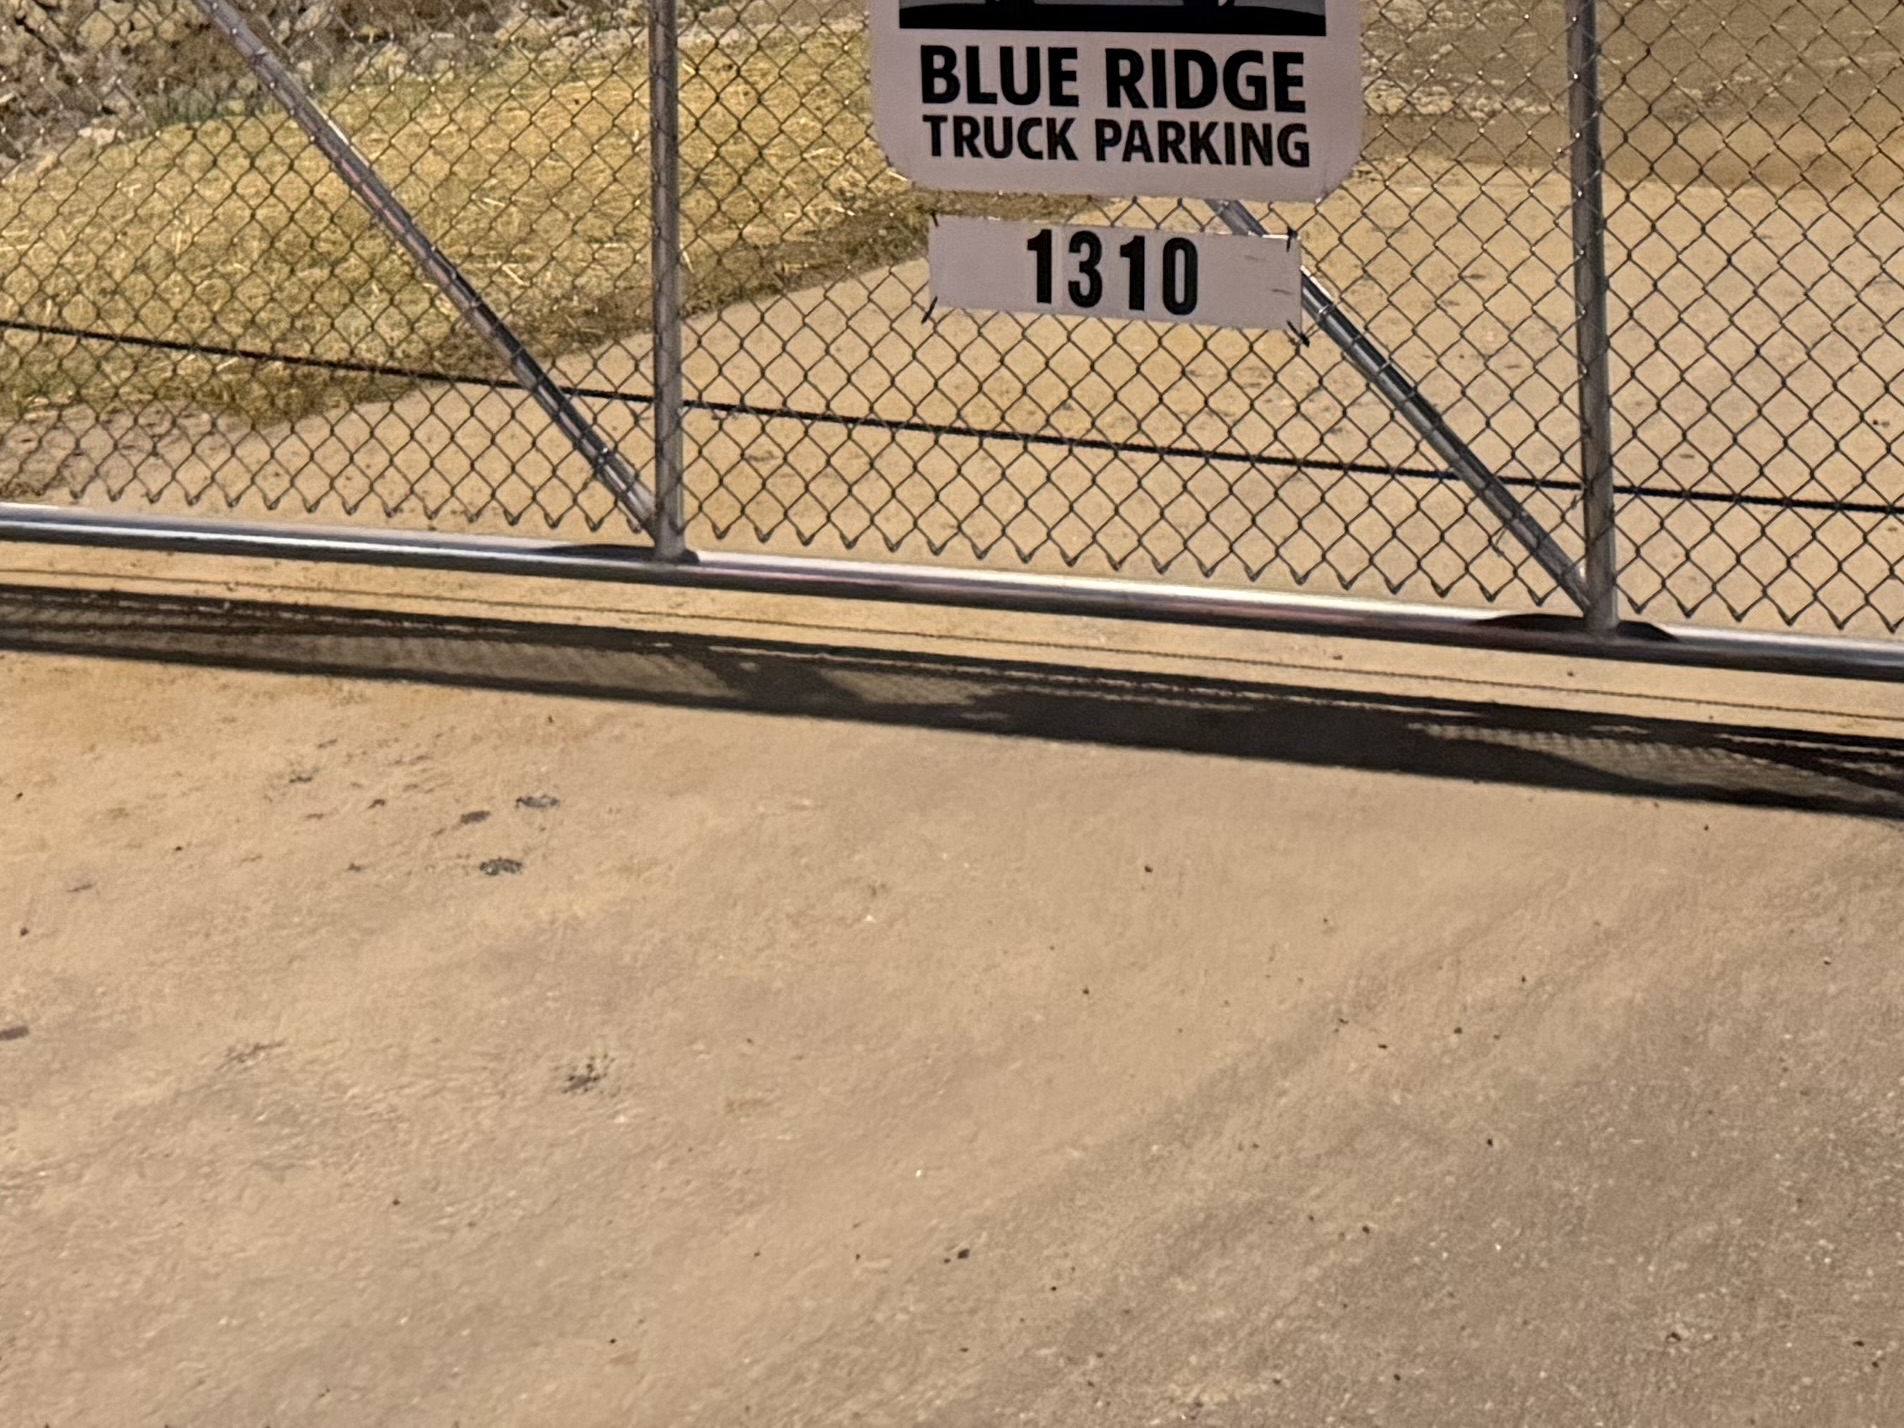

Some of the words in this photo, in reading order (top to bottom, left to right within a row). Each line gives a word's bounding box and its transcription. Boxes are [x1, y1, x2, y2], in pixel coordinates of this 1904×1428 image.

[920, 44, 1080, 107] BLUE
[1104, 48, 1307, 112] RIDGE
[922, 115, 1079, 161] TRUCK
[1094, 118, 1310, 168] PARKING
[1027, 228, 1198, 316] 1310
